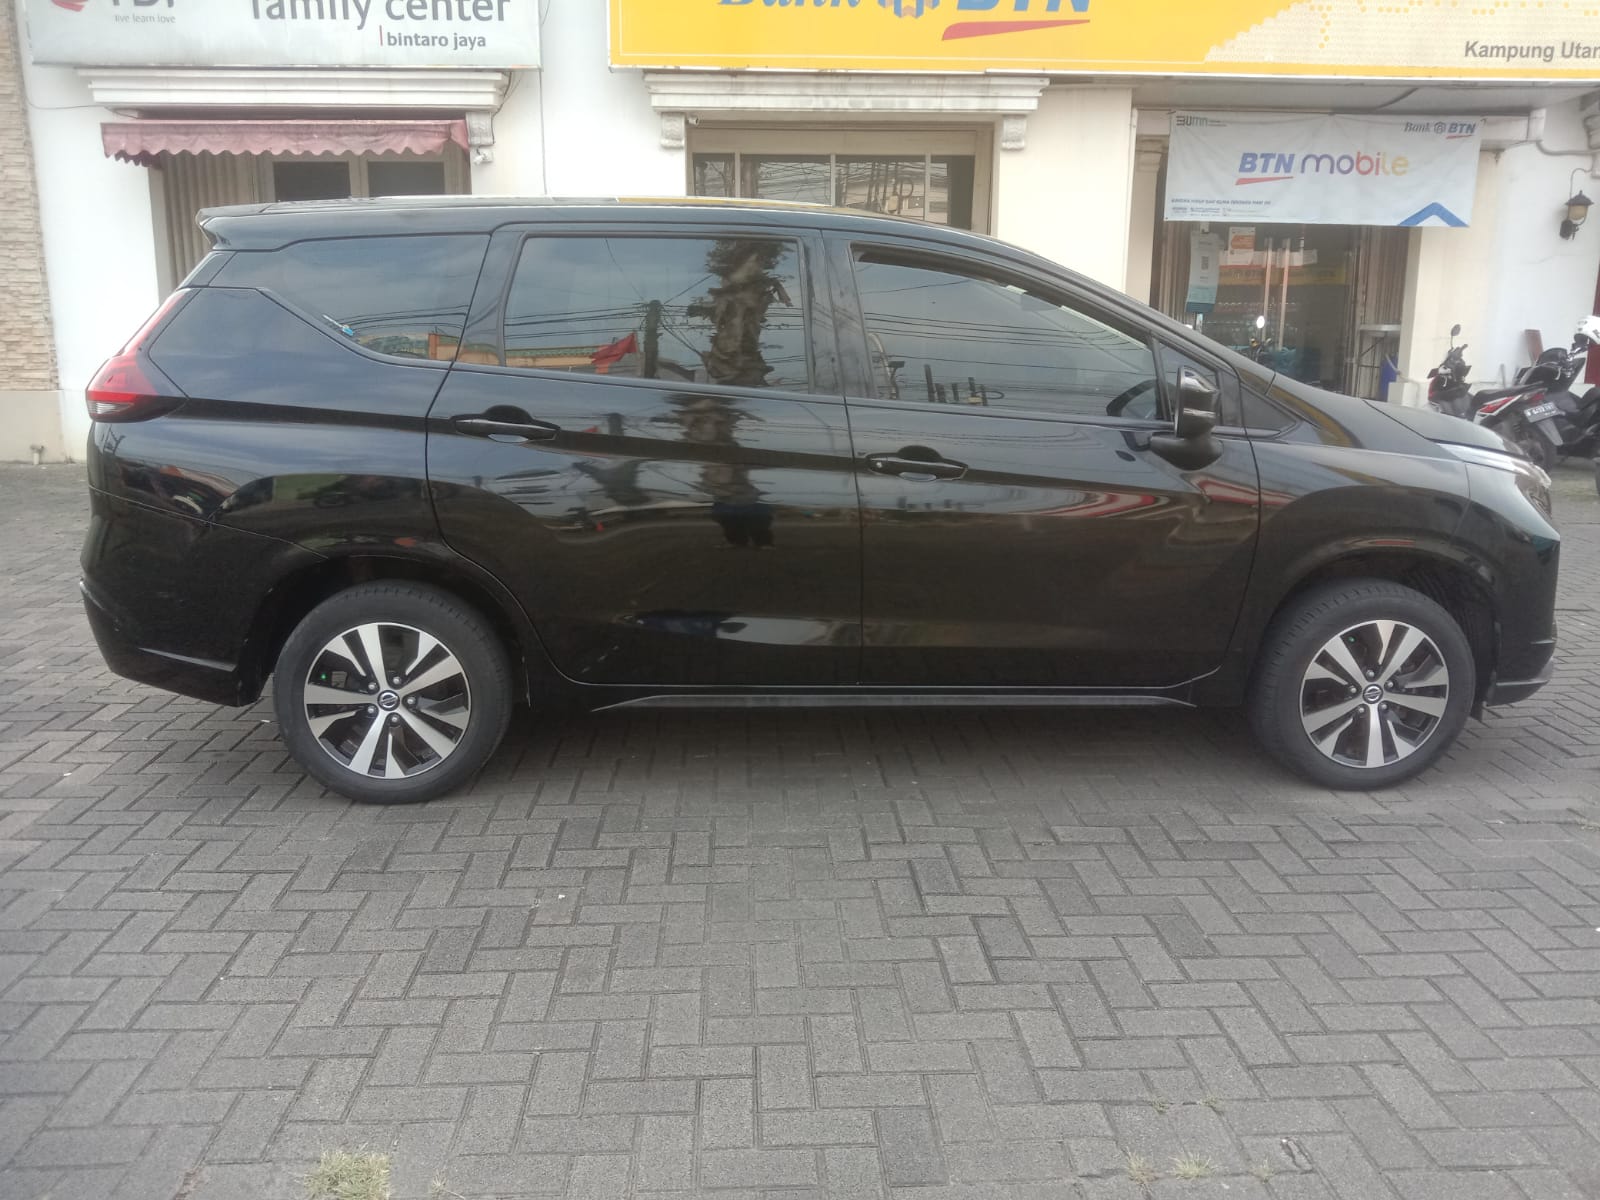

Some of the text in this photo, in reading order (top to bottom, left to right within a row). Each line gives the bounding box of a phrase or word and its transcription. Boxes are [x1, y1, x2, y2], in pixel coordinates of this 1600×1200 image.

[132, 12, 155, 23] learn
[387, 31, 486, 50] bintaro jaya
[1464, 40, 1555, 62] Kampung
[1448, 122, 1476, 134] BTN
[1238, 150, 1410, 176] BTN mobile
